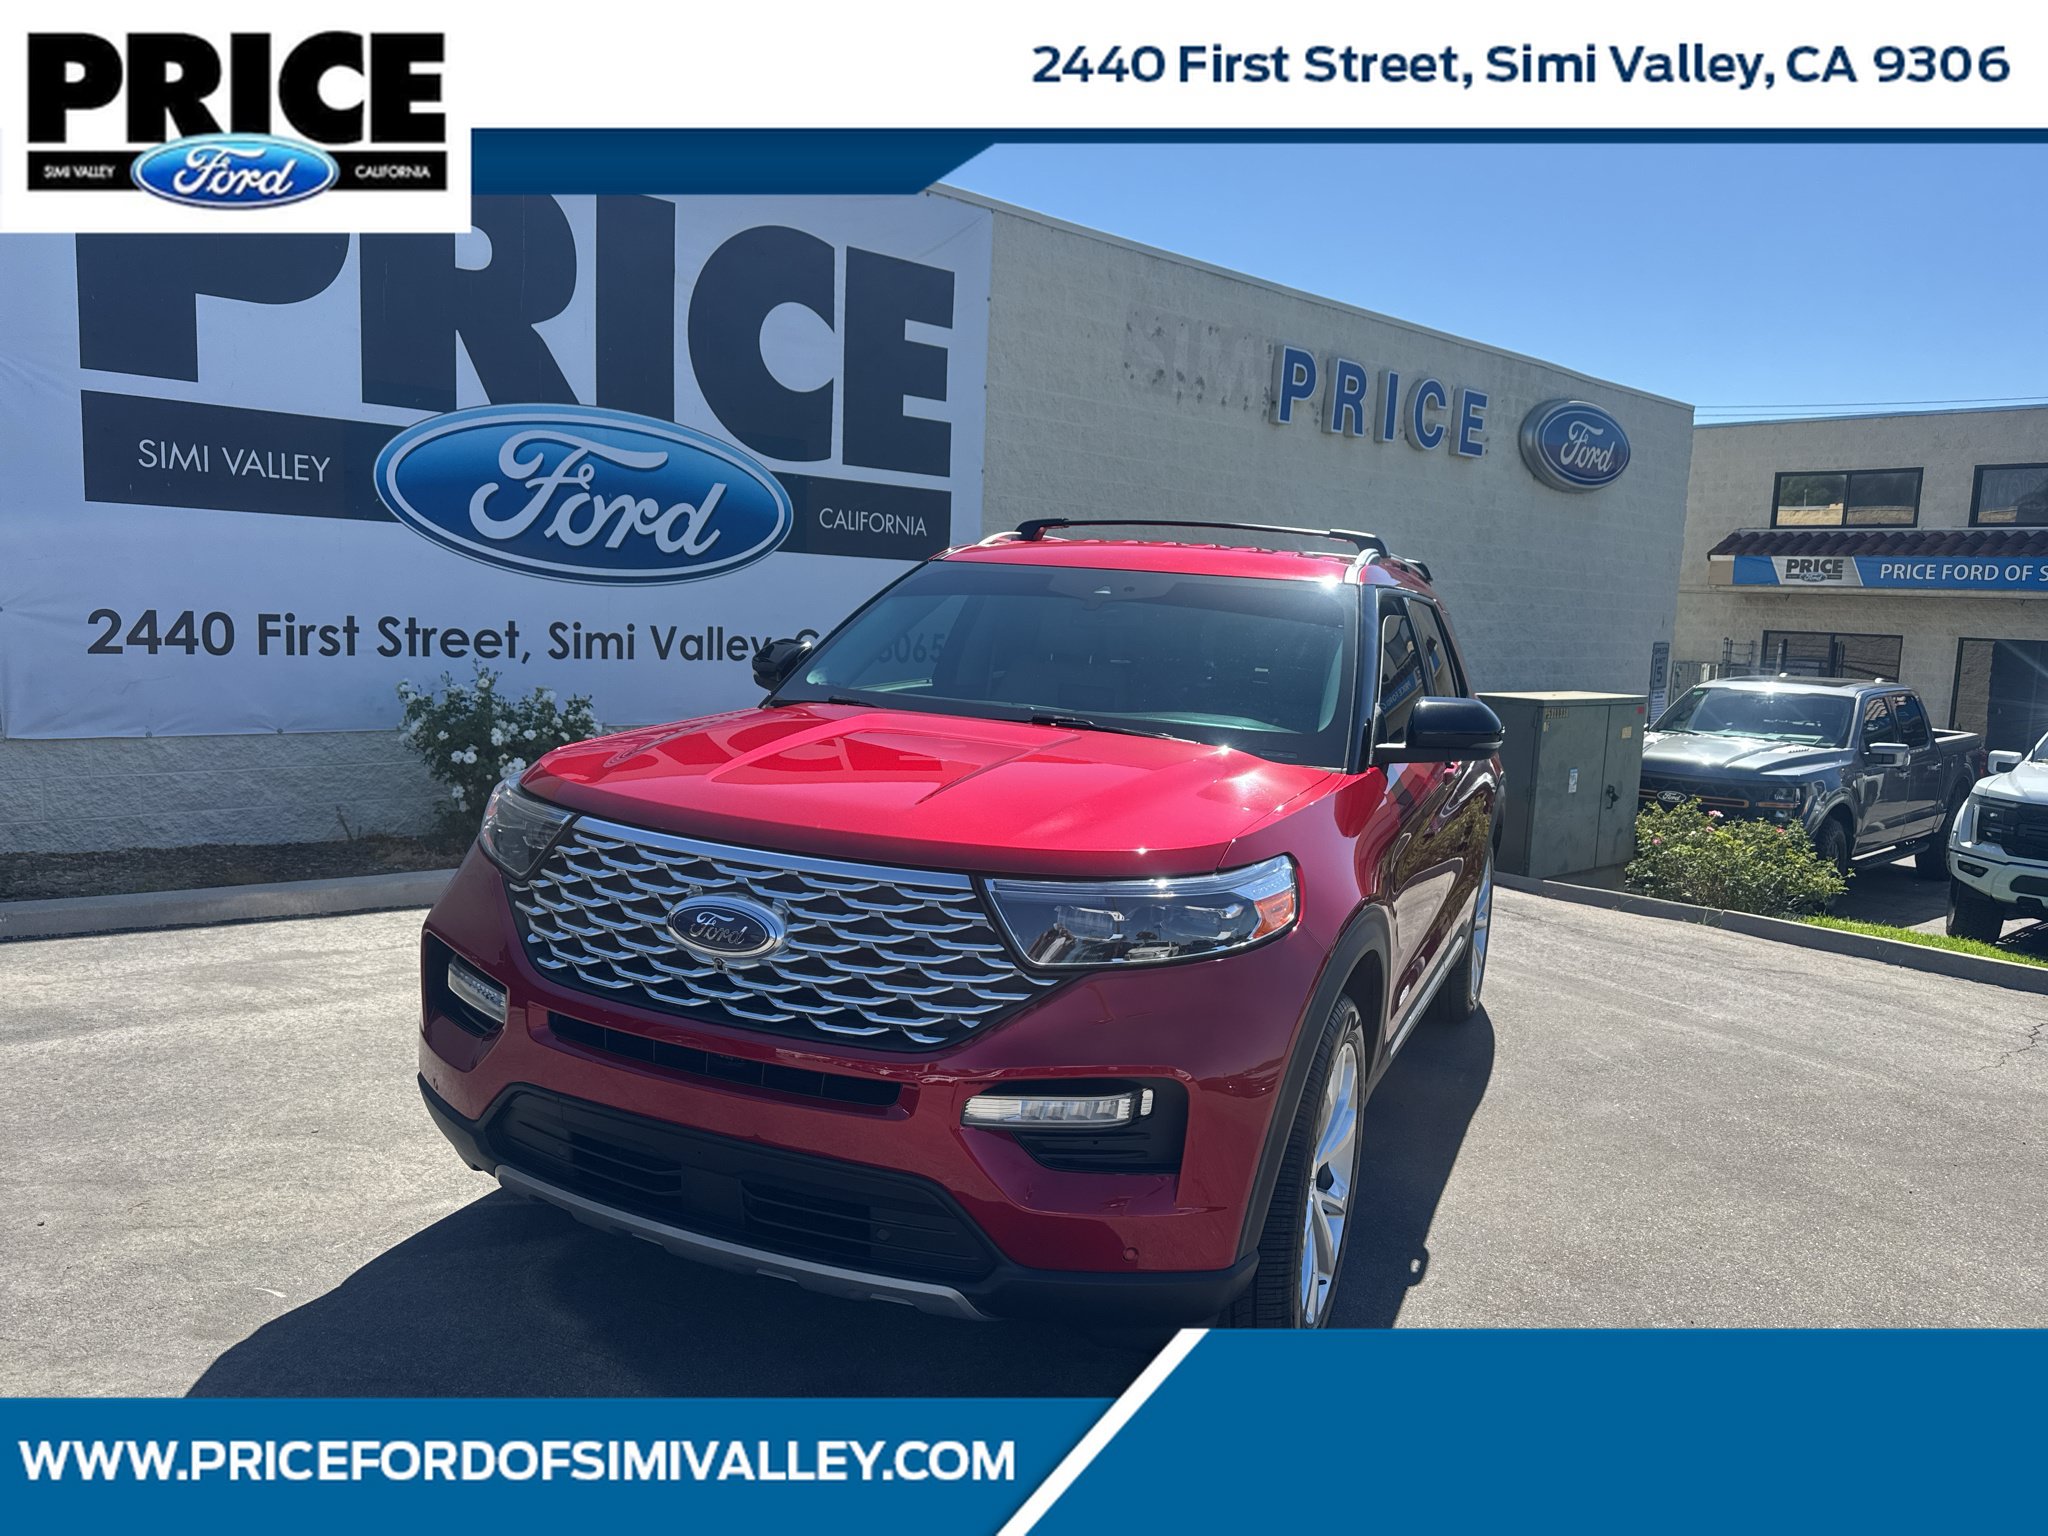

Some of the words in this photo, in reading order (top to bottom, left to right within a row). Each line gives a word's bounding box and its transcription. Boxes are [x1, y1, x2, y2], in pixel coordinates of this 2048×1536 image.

[1273, 344, 1490, 459] PRICE
[138, 438, 209, 473] SIMI
[221, 447, 331, 483] VALLEY
[1560, 420, 1615, 473] Ford
[468, 429, 728, 556] Ford
[818, 506, 928, 537] CALIFORNIA
[1785, 558, 1844, 574] PRICE
[1880, 563, 1937, 580] PRICE
[1941, 564, 1999, 581] FORD
[2004, 565, 2034, 582] OF
[87, 608, 235, 656] 2440
[258, 612, 360, 657] First
[376, 615, 532, 665] Street,
[547, 621, 636, 660] Simi
[688, 911, 749, 945] Ford
